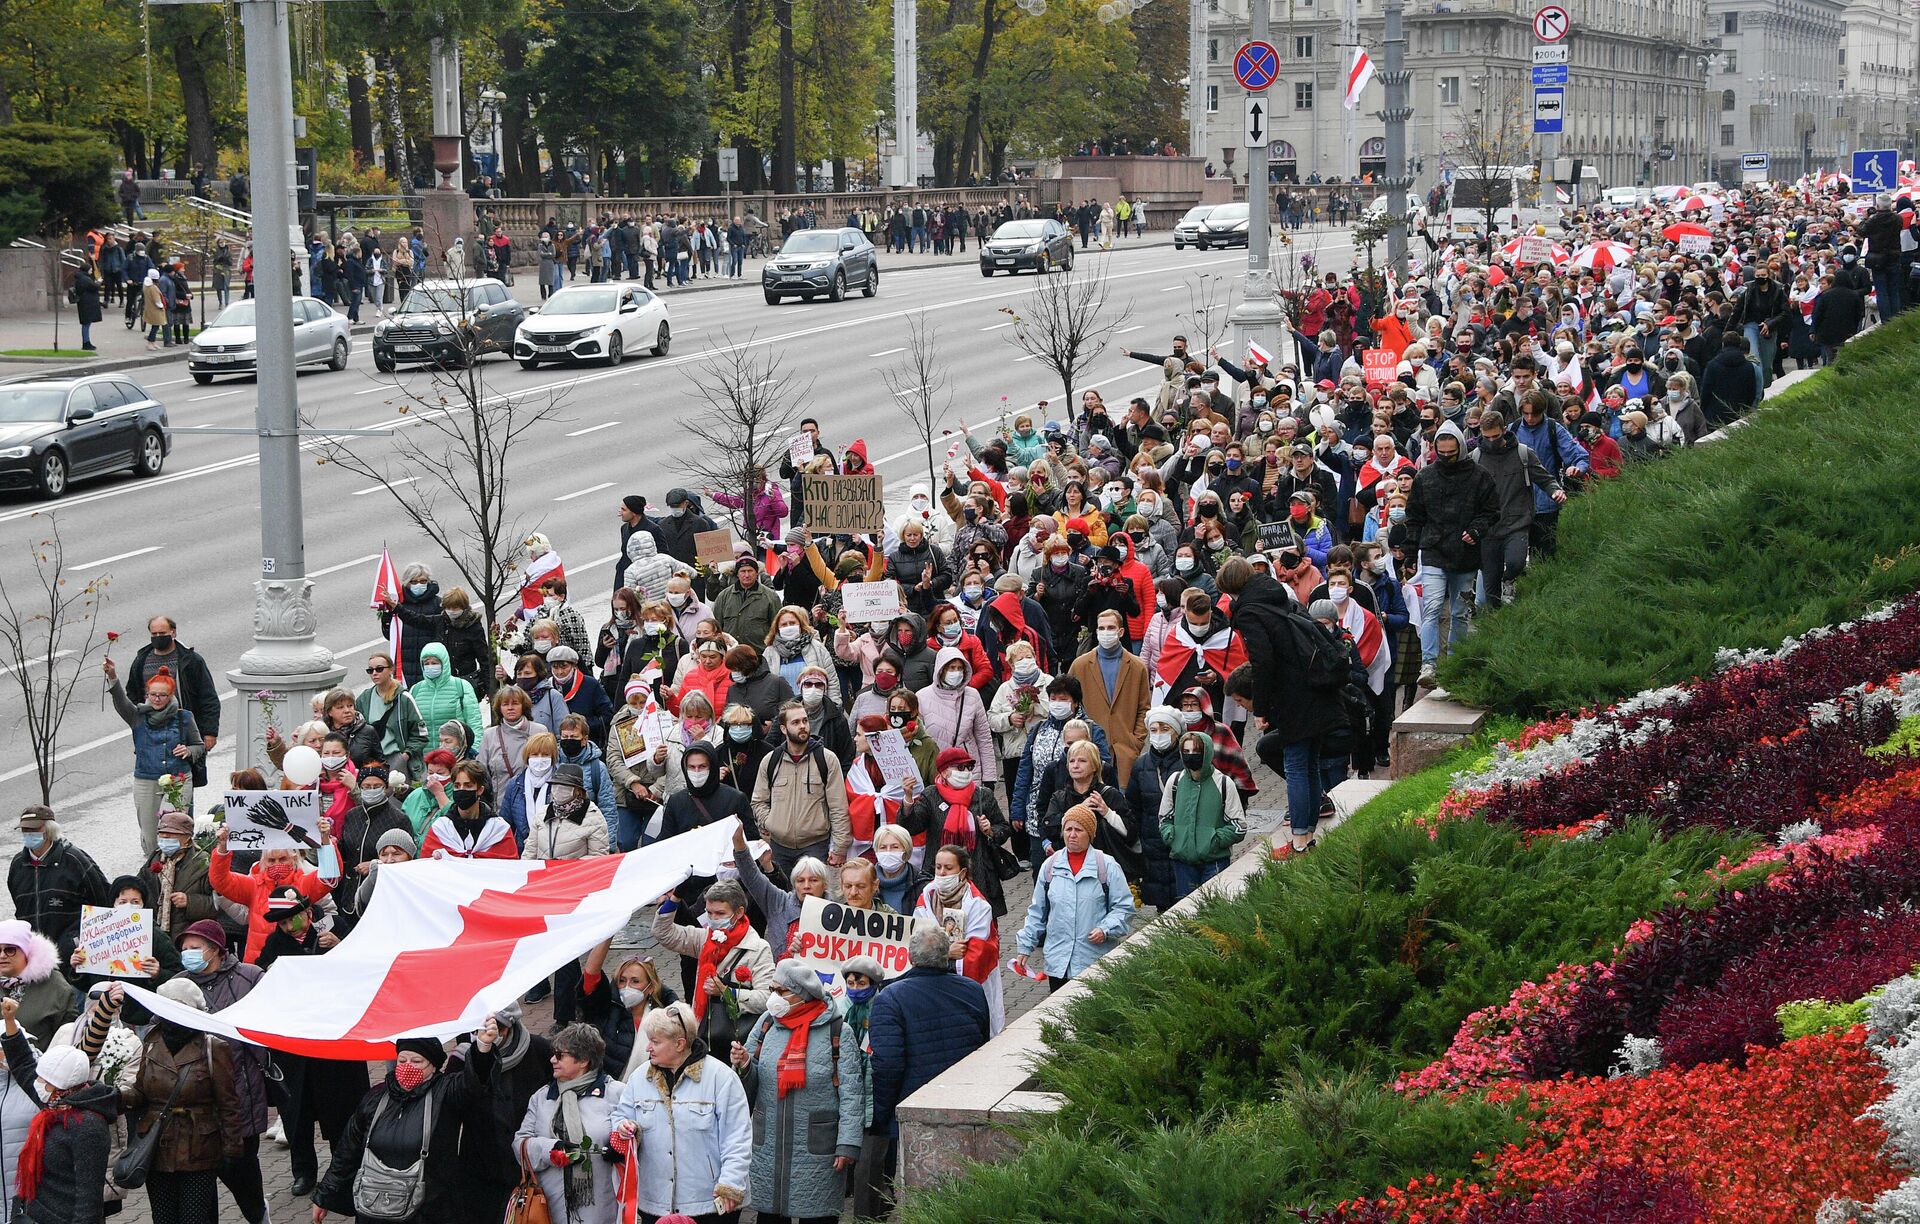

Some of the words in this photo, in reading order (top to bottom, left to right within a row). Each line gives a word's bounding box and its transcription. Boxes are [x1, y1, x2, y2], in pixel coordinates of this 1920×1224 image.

[1365, 352, 1395, 366] STOP
[803, 477, 829, 501] КТО
[833, 477, 876, 502] РАЗВЯЗАЛ
[805, 503, 813, 528] У
[815, 504, 833, 528] НАС
[836, 500, 882, 529] ВОЙНУ??
[1260, 524, 1288, 536] ПРАВДА
[855, 582, 889, 591] ЗАРПЛАТА
[848, 610, 856, 618] НЕ
[880, 732, 897, 744] МЫ
[885, 745, 898, 755] ЗА
[224, 795, 249, 808] ТИК
[283, 792, 312, 808] ТАК!
[821, 903, 905, 941] ОМОН
[88, 949, 110, 966] КУРАМ
[111, 944, 122, 956] НА
[122, 934, 149, 952] СМЕХ!!!
[799, 932, 863, 962] РУКИ
[867, 942, 912, 972] ПРО
